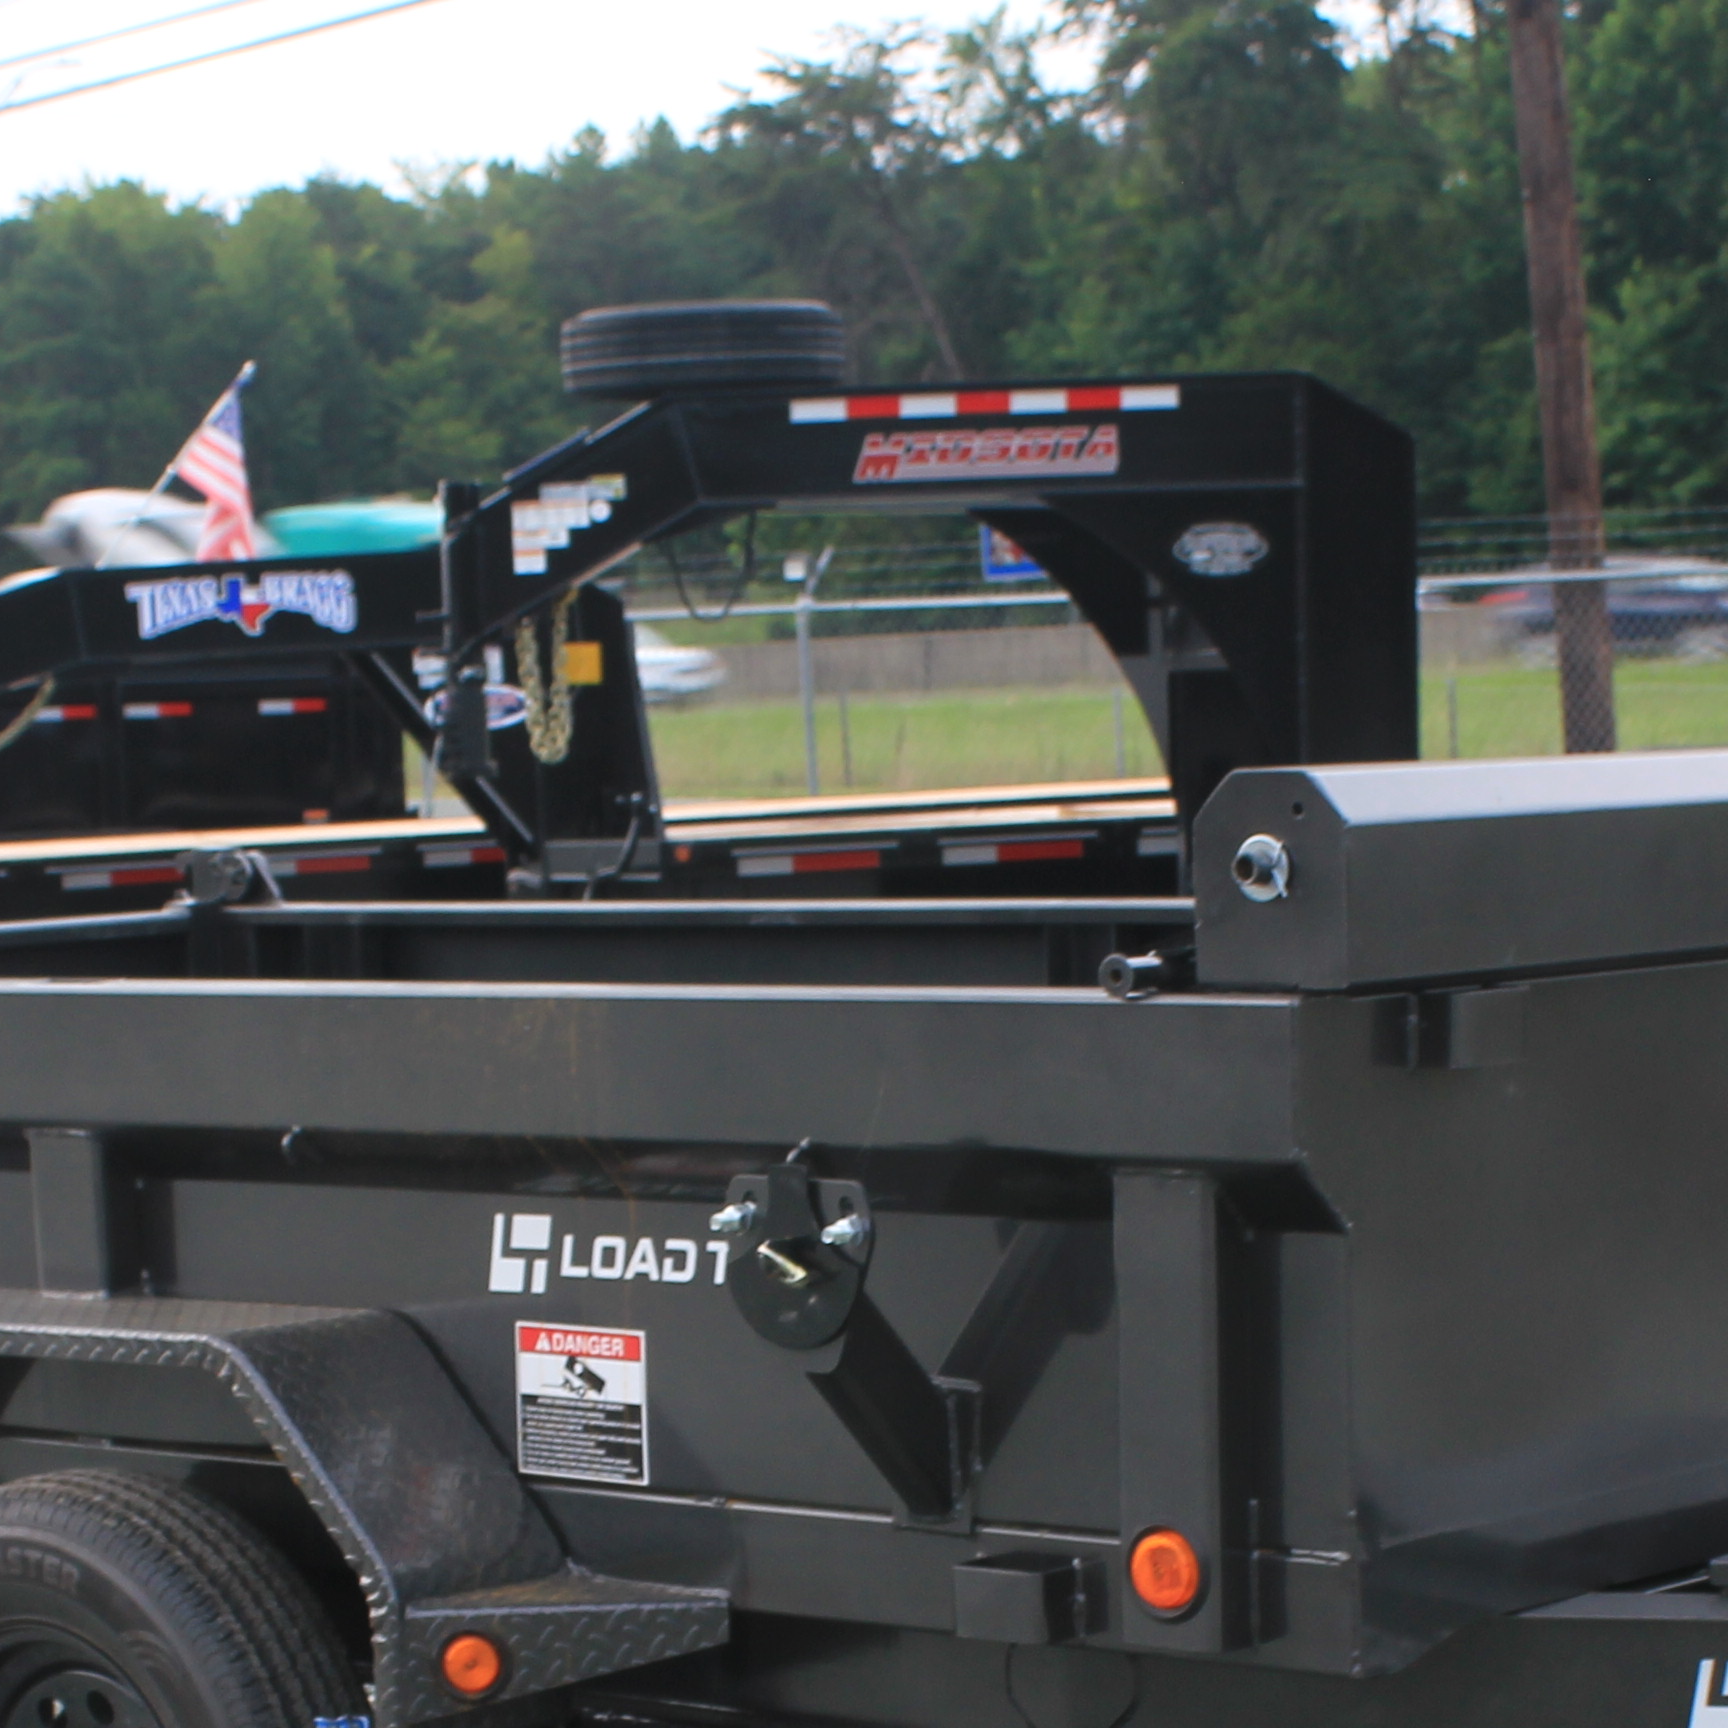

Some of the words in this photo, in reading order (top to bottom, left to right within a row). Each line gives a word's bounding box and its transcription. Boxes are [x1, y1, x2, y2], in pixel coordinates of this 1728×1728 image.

[125, 576, 219, 639] TEXAS
[260, 569, 357, 633] BRAGG
[551, 1331, 625, 1358] DANGER
